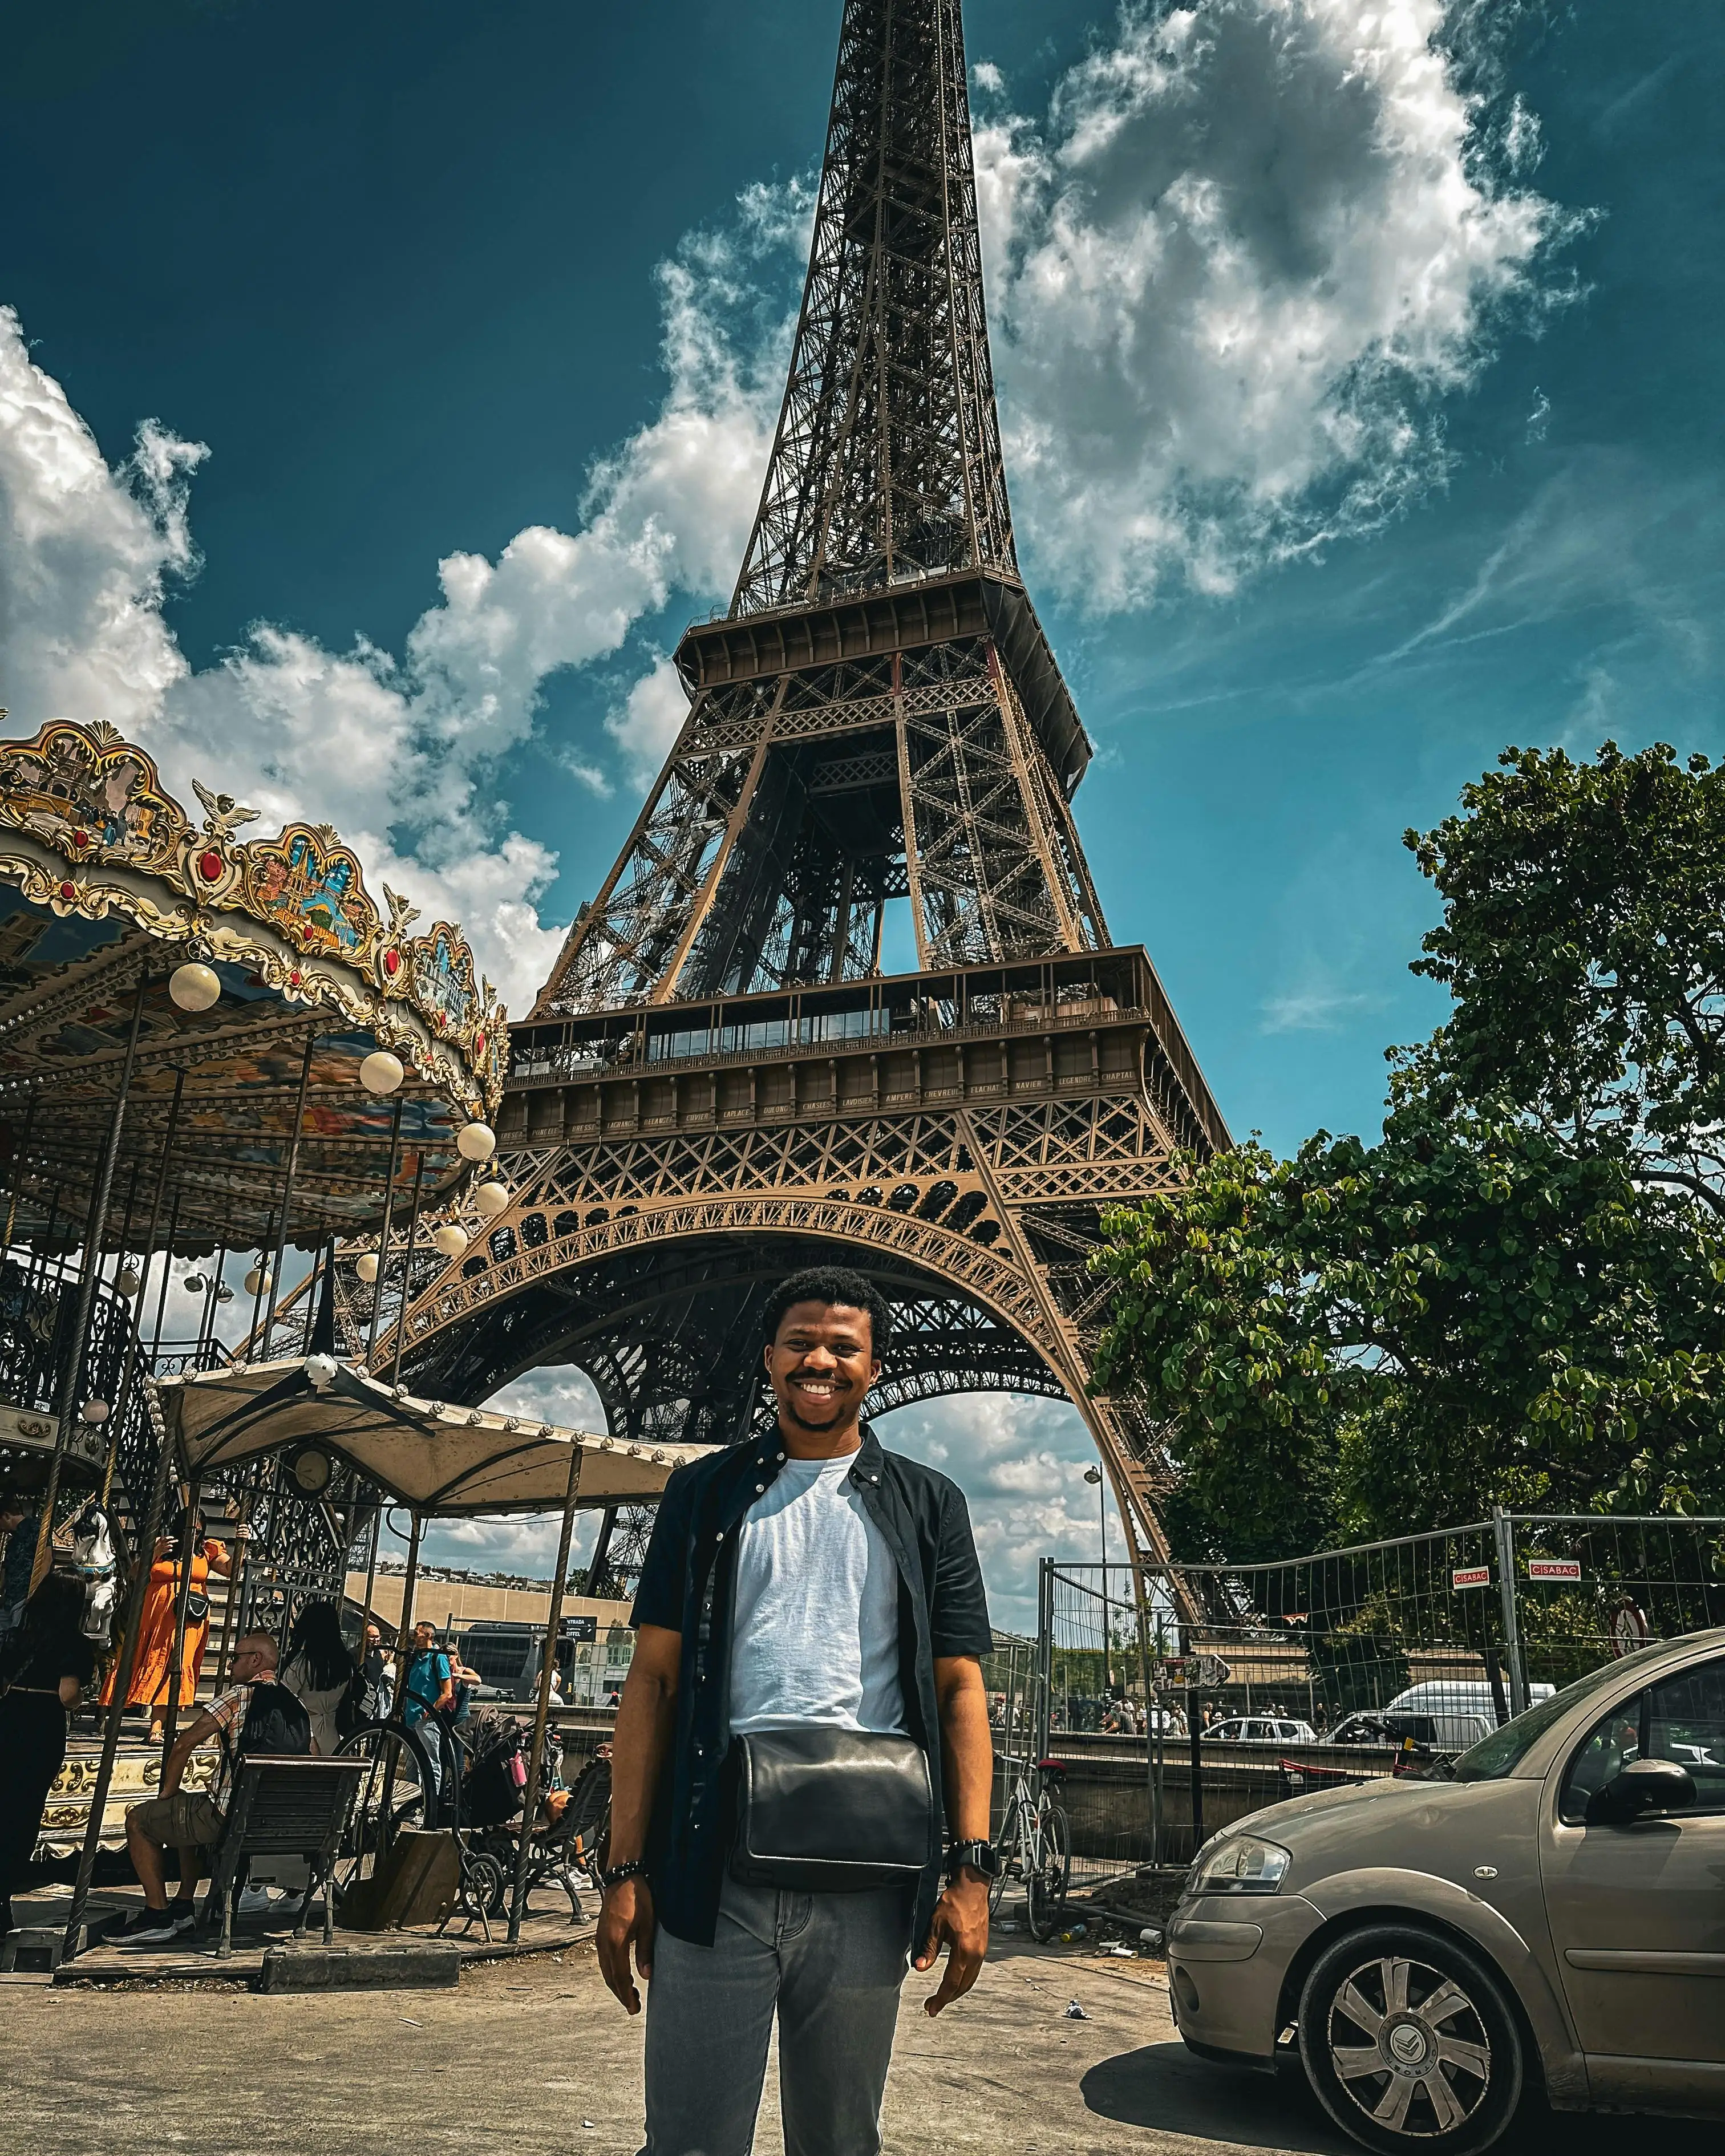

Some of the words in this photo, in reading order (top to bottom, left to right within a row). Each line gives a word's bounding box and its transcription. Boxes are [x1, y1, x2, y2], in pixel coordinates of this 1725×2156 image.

[1059, 1075, 1092, 1085] LEGENDRE
[1102, 1071, 1133, 1080] CHAPTAL
[971, 1084, 999, 1093] FLACHAT
[1015, 1080, 1041, 1089] NAVIER
[843, 1097, 872, 1106] LAVOISIER
[886, 1093, 913, 1101] AMPERE
